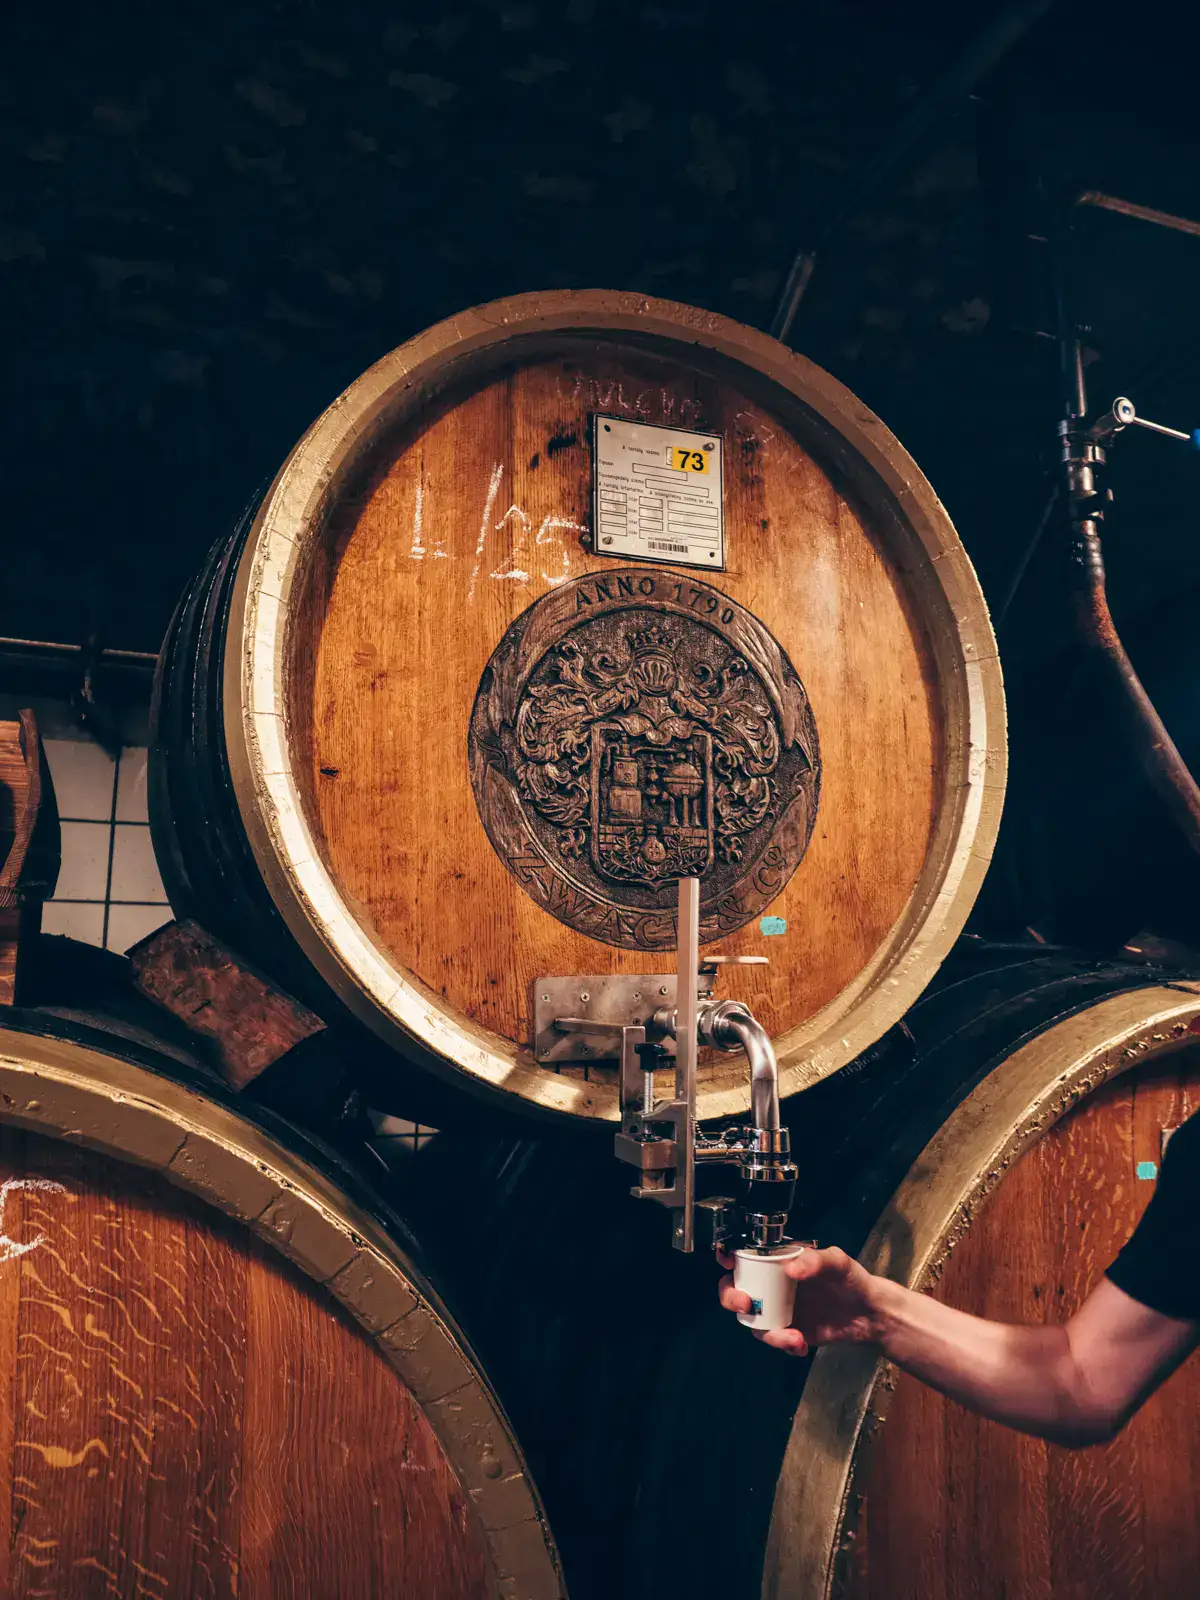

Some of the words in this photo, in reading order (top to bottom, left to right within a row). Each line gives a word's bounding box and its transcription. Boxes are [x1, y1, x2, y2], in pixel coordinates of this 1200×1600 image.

[678, 450, 704, 471] 73
[575, 575, 655, 611] ANNO
[673, 583, 735, 625] 1790
